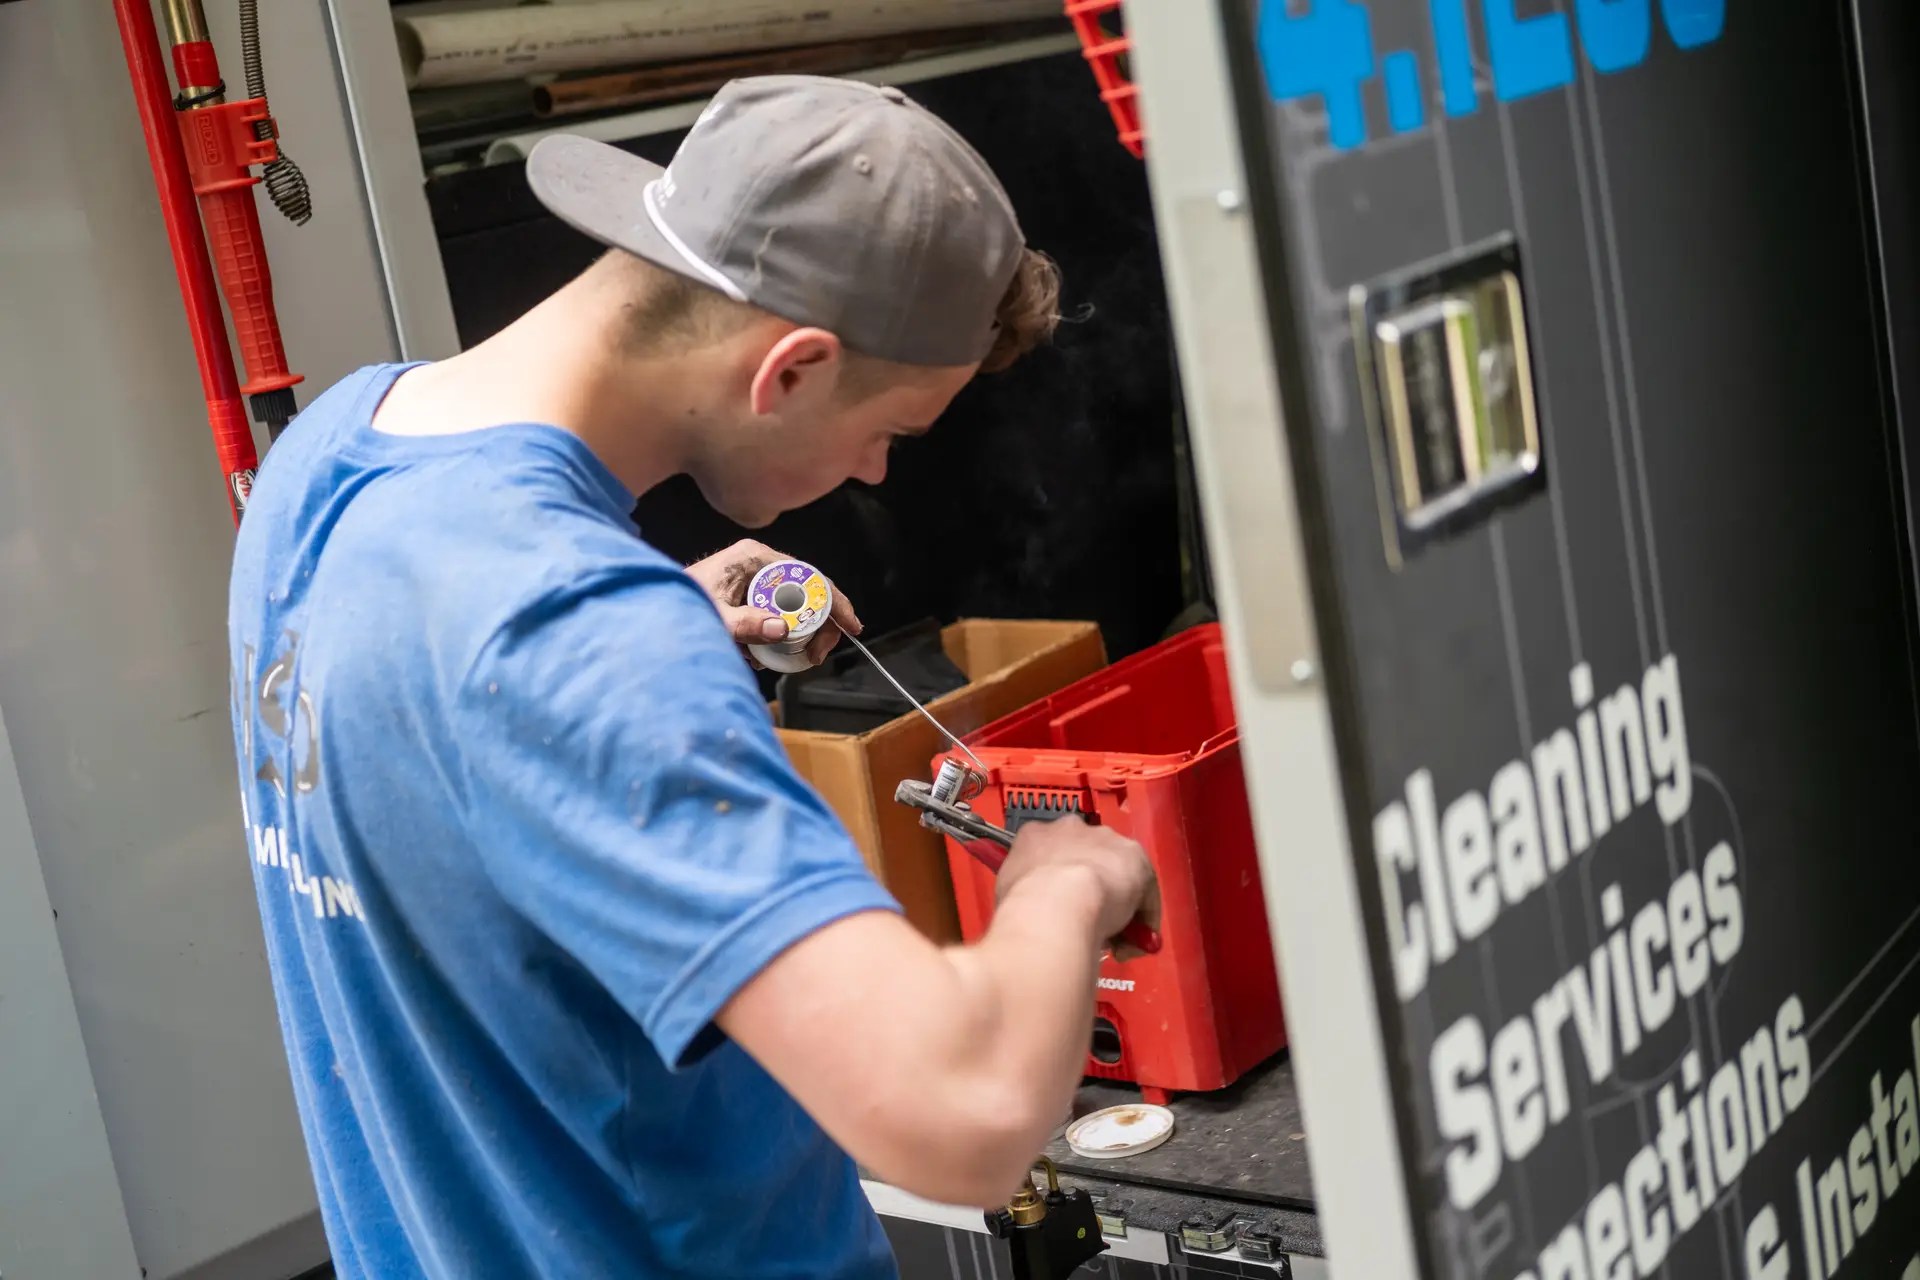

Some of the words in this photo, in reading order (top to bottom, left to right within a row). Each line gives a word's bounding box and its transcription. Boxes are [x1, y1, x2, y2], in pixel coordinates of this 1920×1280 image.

[198, 116, 218, 164] RIDGID
[1372, 653, 1692, 1001] Cleaning
[1096, 977, 1136, 992] KOUT
[1430, 841, 1744, 1209] Services
[1513, 995, 1811, 1280] ections
